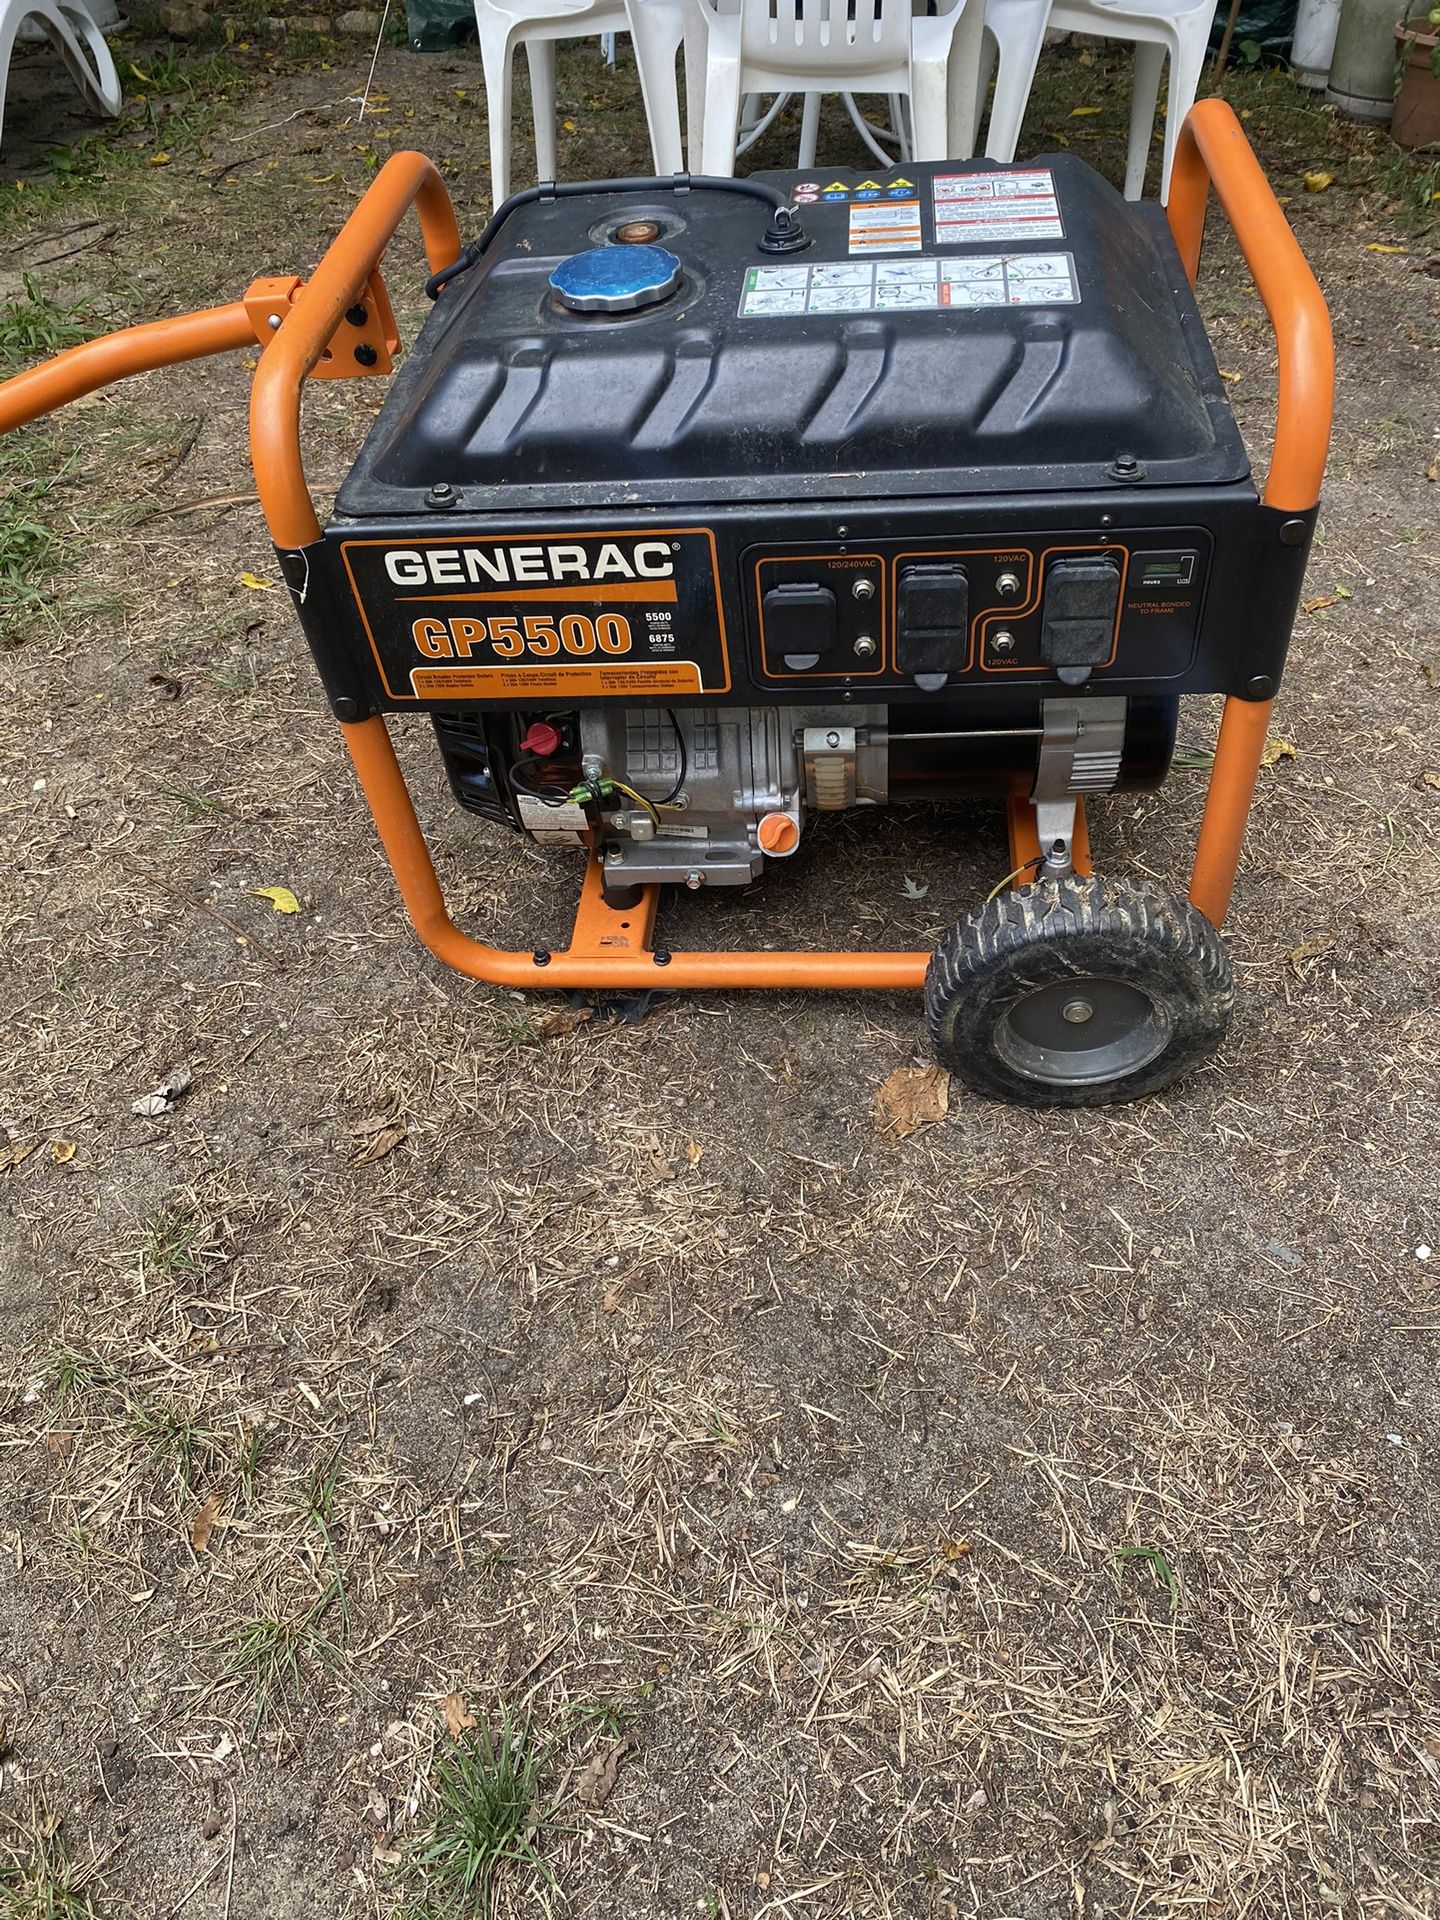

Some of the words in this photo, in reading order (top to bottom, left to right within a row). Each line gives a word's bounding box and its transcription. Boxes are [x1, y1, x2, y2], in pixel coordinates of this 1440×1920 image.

[993, 554, 1027, 563] 120VAC
[384, 542, 674, 585] GENERAC
[827, 559, 877, 569] 120/240VAC
[1128, 601, 1160, 609] NEUTRAL
[1160, 600, 1191, 608] BONDED
[645, 612, 672, 621] 5500
[411, 613, 633, 659] GP5500
[648, 633, 675, 643] 6875
[987, 657, 1019, 666] 120VAC
